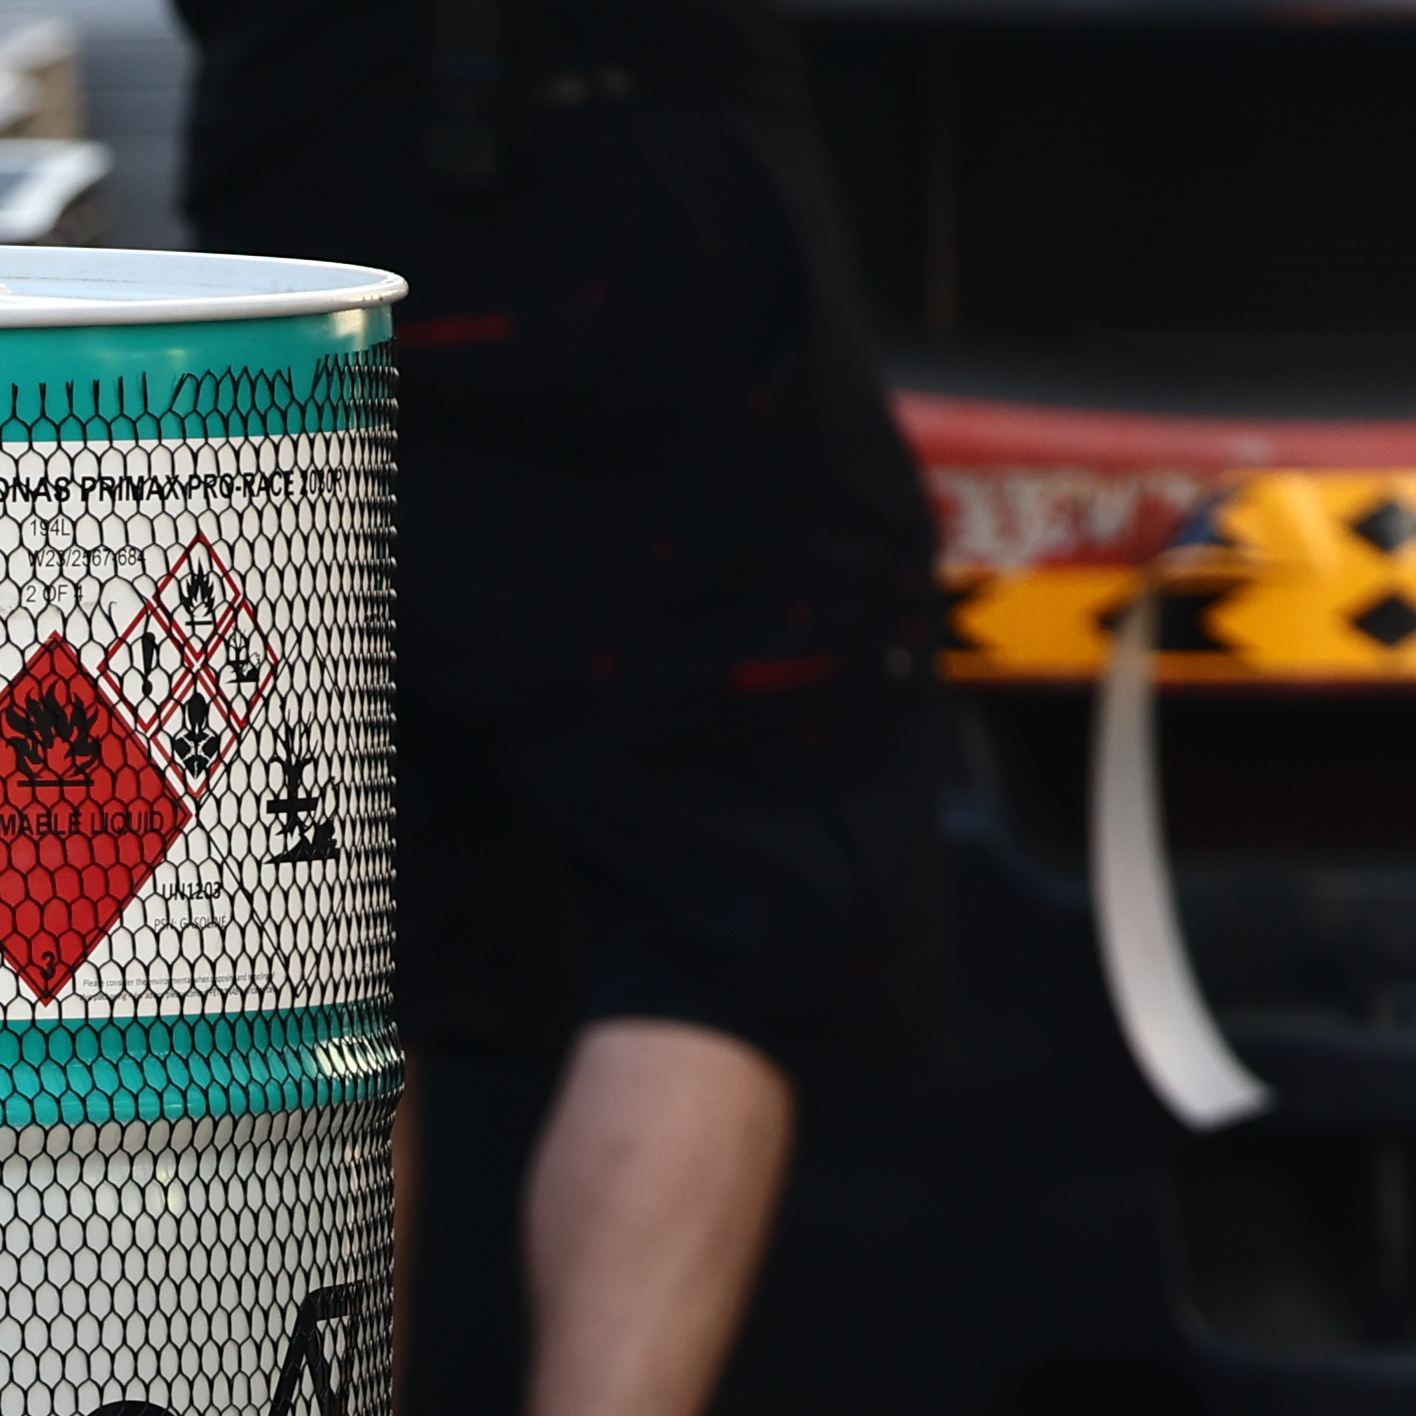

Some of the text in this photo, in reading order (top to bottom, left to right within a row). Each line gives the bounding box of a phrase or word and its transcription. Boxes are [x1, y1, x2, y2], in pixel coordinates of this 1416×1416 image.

[81, 474, 180, 502] PRIMAX
[187, 469, 295, 500] PRO-RACE
[29, 519, 71, 537] 194L
[25, 584, 37, 603] 2
[42, 584, 69, 602] OF
[91, 810, 165, 835] LIQUID
[162, 881, 221, 901] UN1203
[179, 914, 227, 930] GSOLINE
[40, 951, 57, 981] 3
